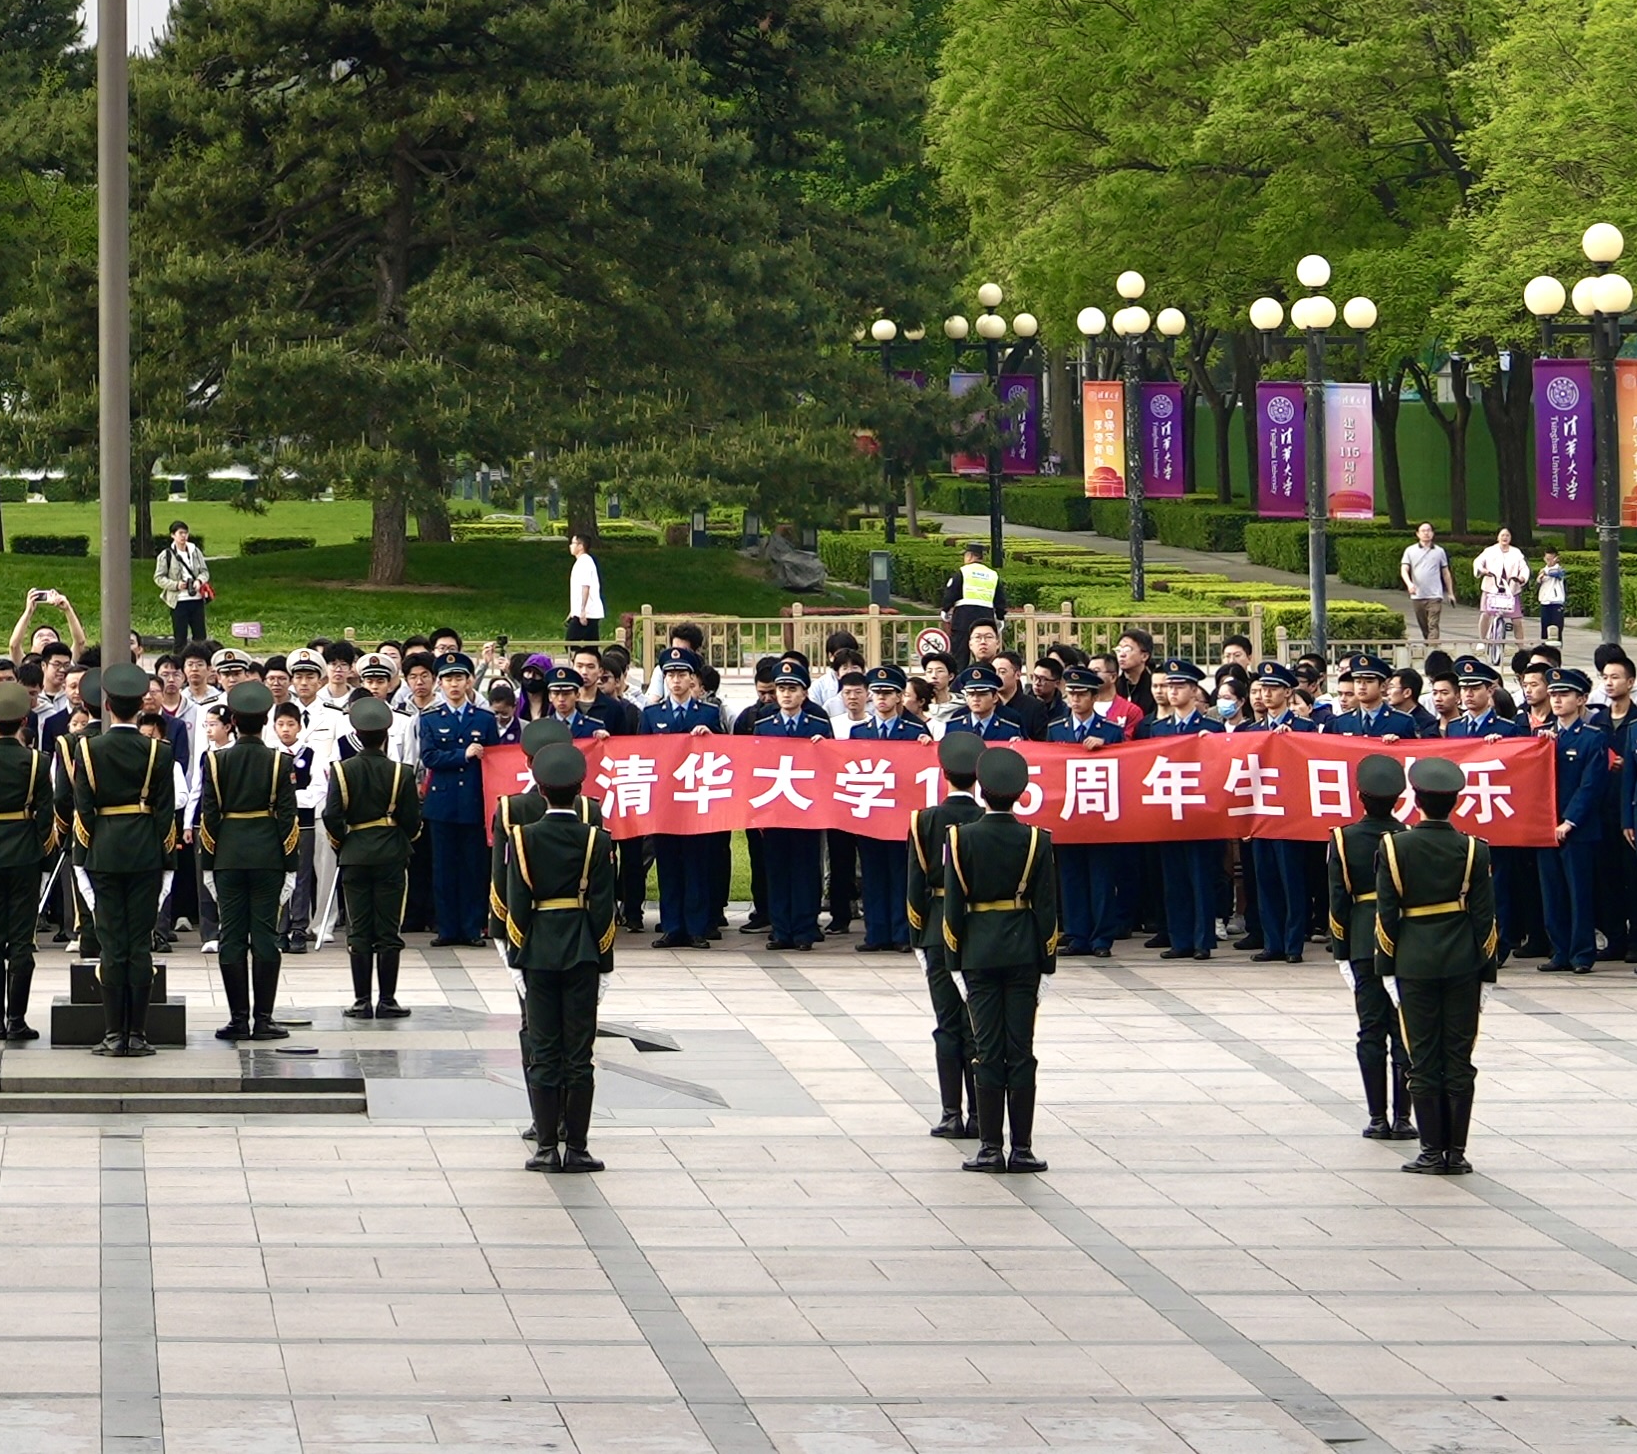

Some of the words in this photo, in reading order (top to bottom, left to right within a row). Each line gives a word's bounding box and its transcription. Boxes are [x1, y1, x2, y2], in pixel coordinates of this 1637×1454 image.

[1340, 417, 1361, 486] 建校115周年
[1549, 415, 1559, 454] Tsinghua
[1550, 455, 1561, 499] University
[516, 751, 1515, 825] 清华大学15周年生日乐
